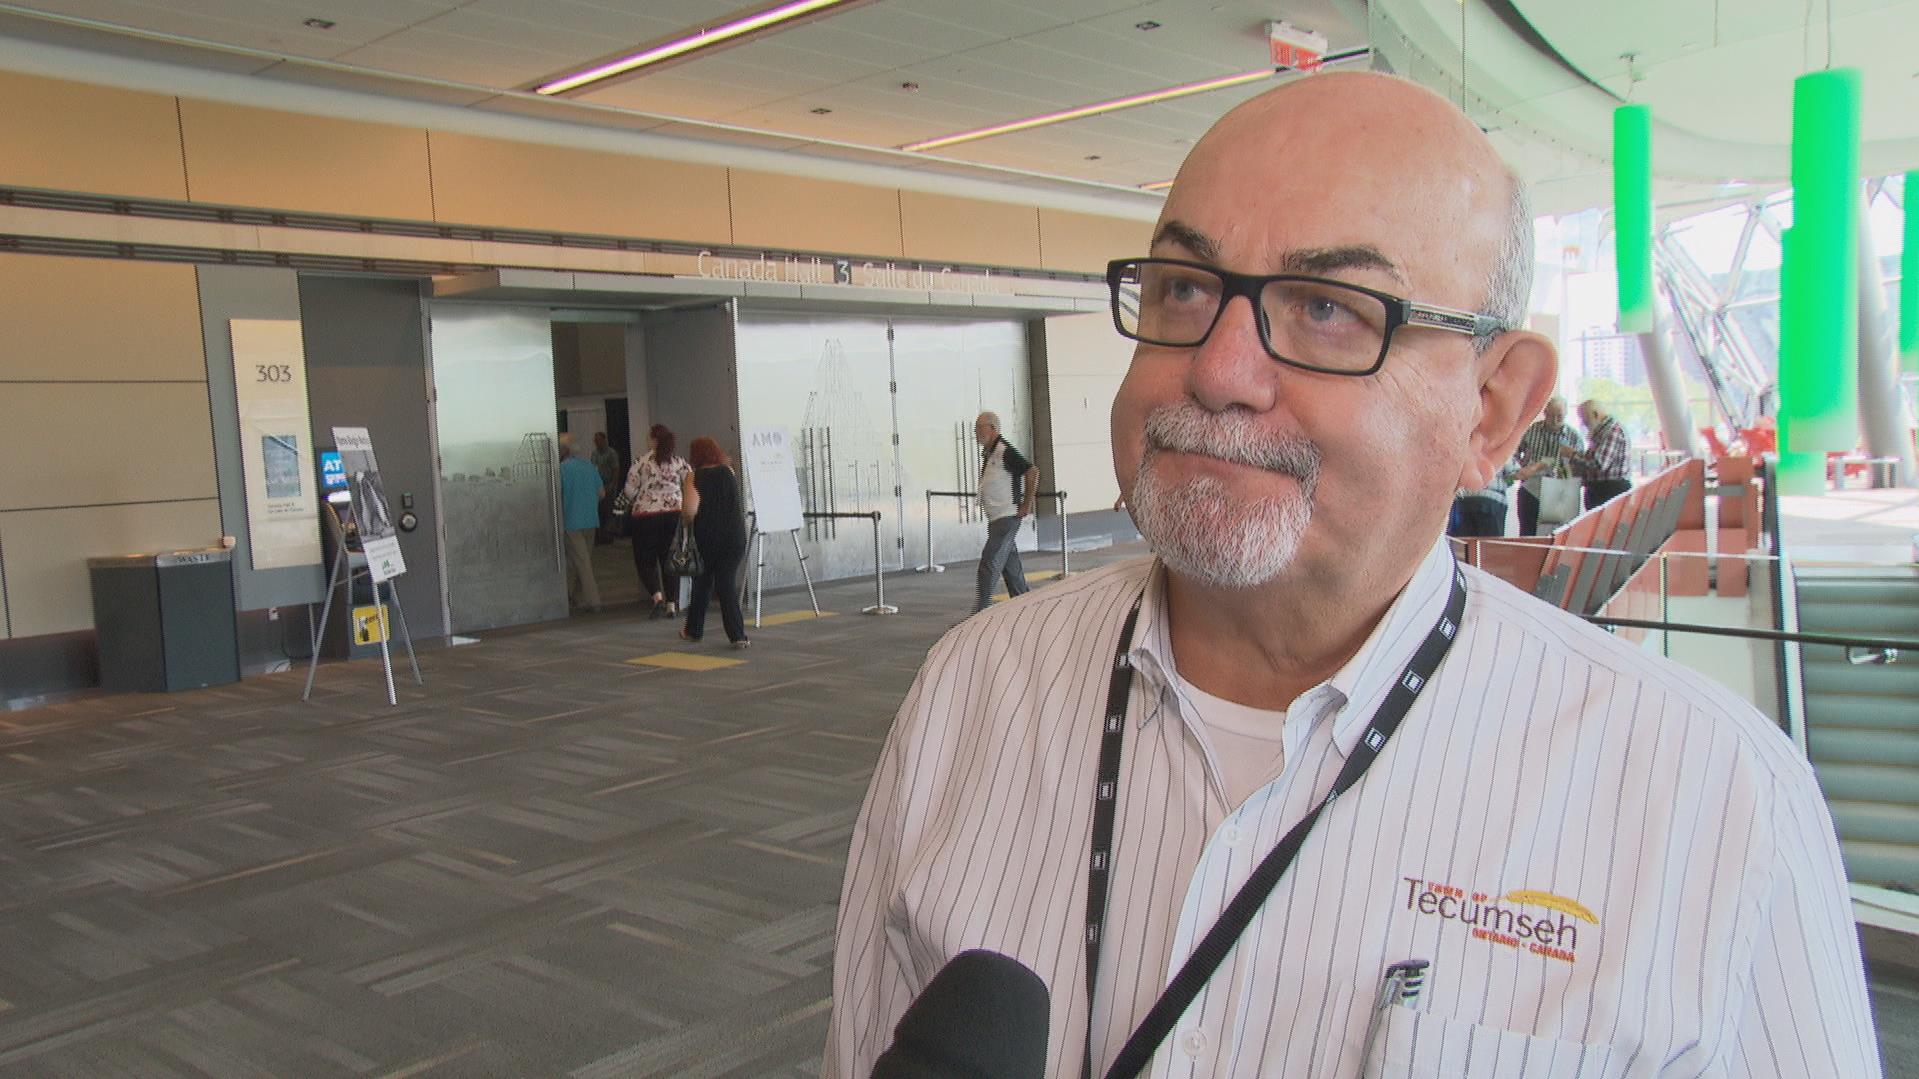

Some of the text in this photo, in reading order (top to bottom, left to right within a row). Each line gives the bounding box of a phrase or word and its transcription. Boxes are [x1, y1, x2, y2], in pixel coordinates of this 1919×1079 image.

[697, 250, 778, 282] Canada
[836, 258, 850, 286] 3
[255, 364, 292, 383] 303
[1403, 877, 1577, 949] Tecumseh
[1529, 942, 1575, 962] CANADA
